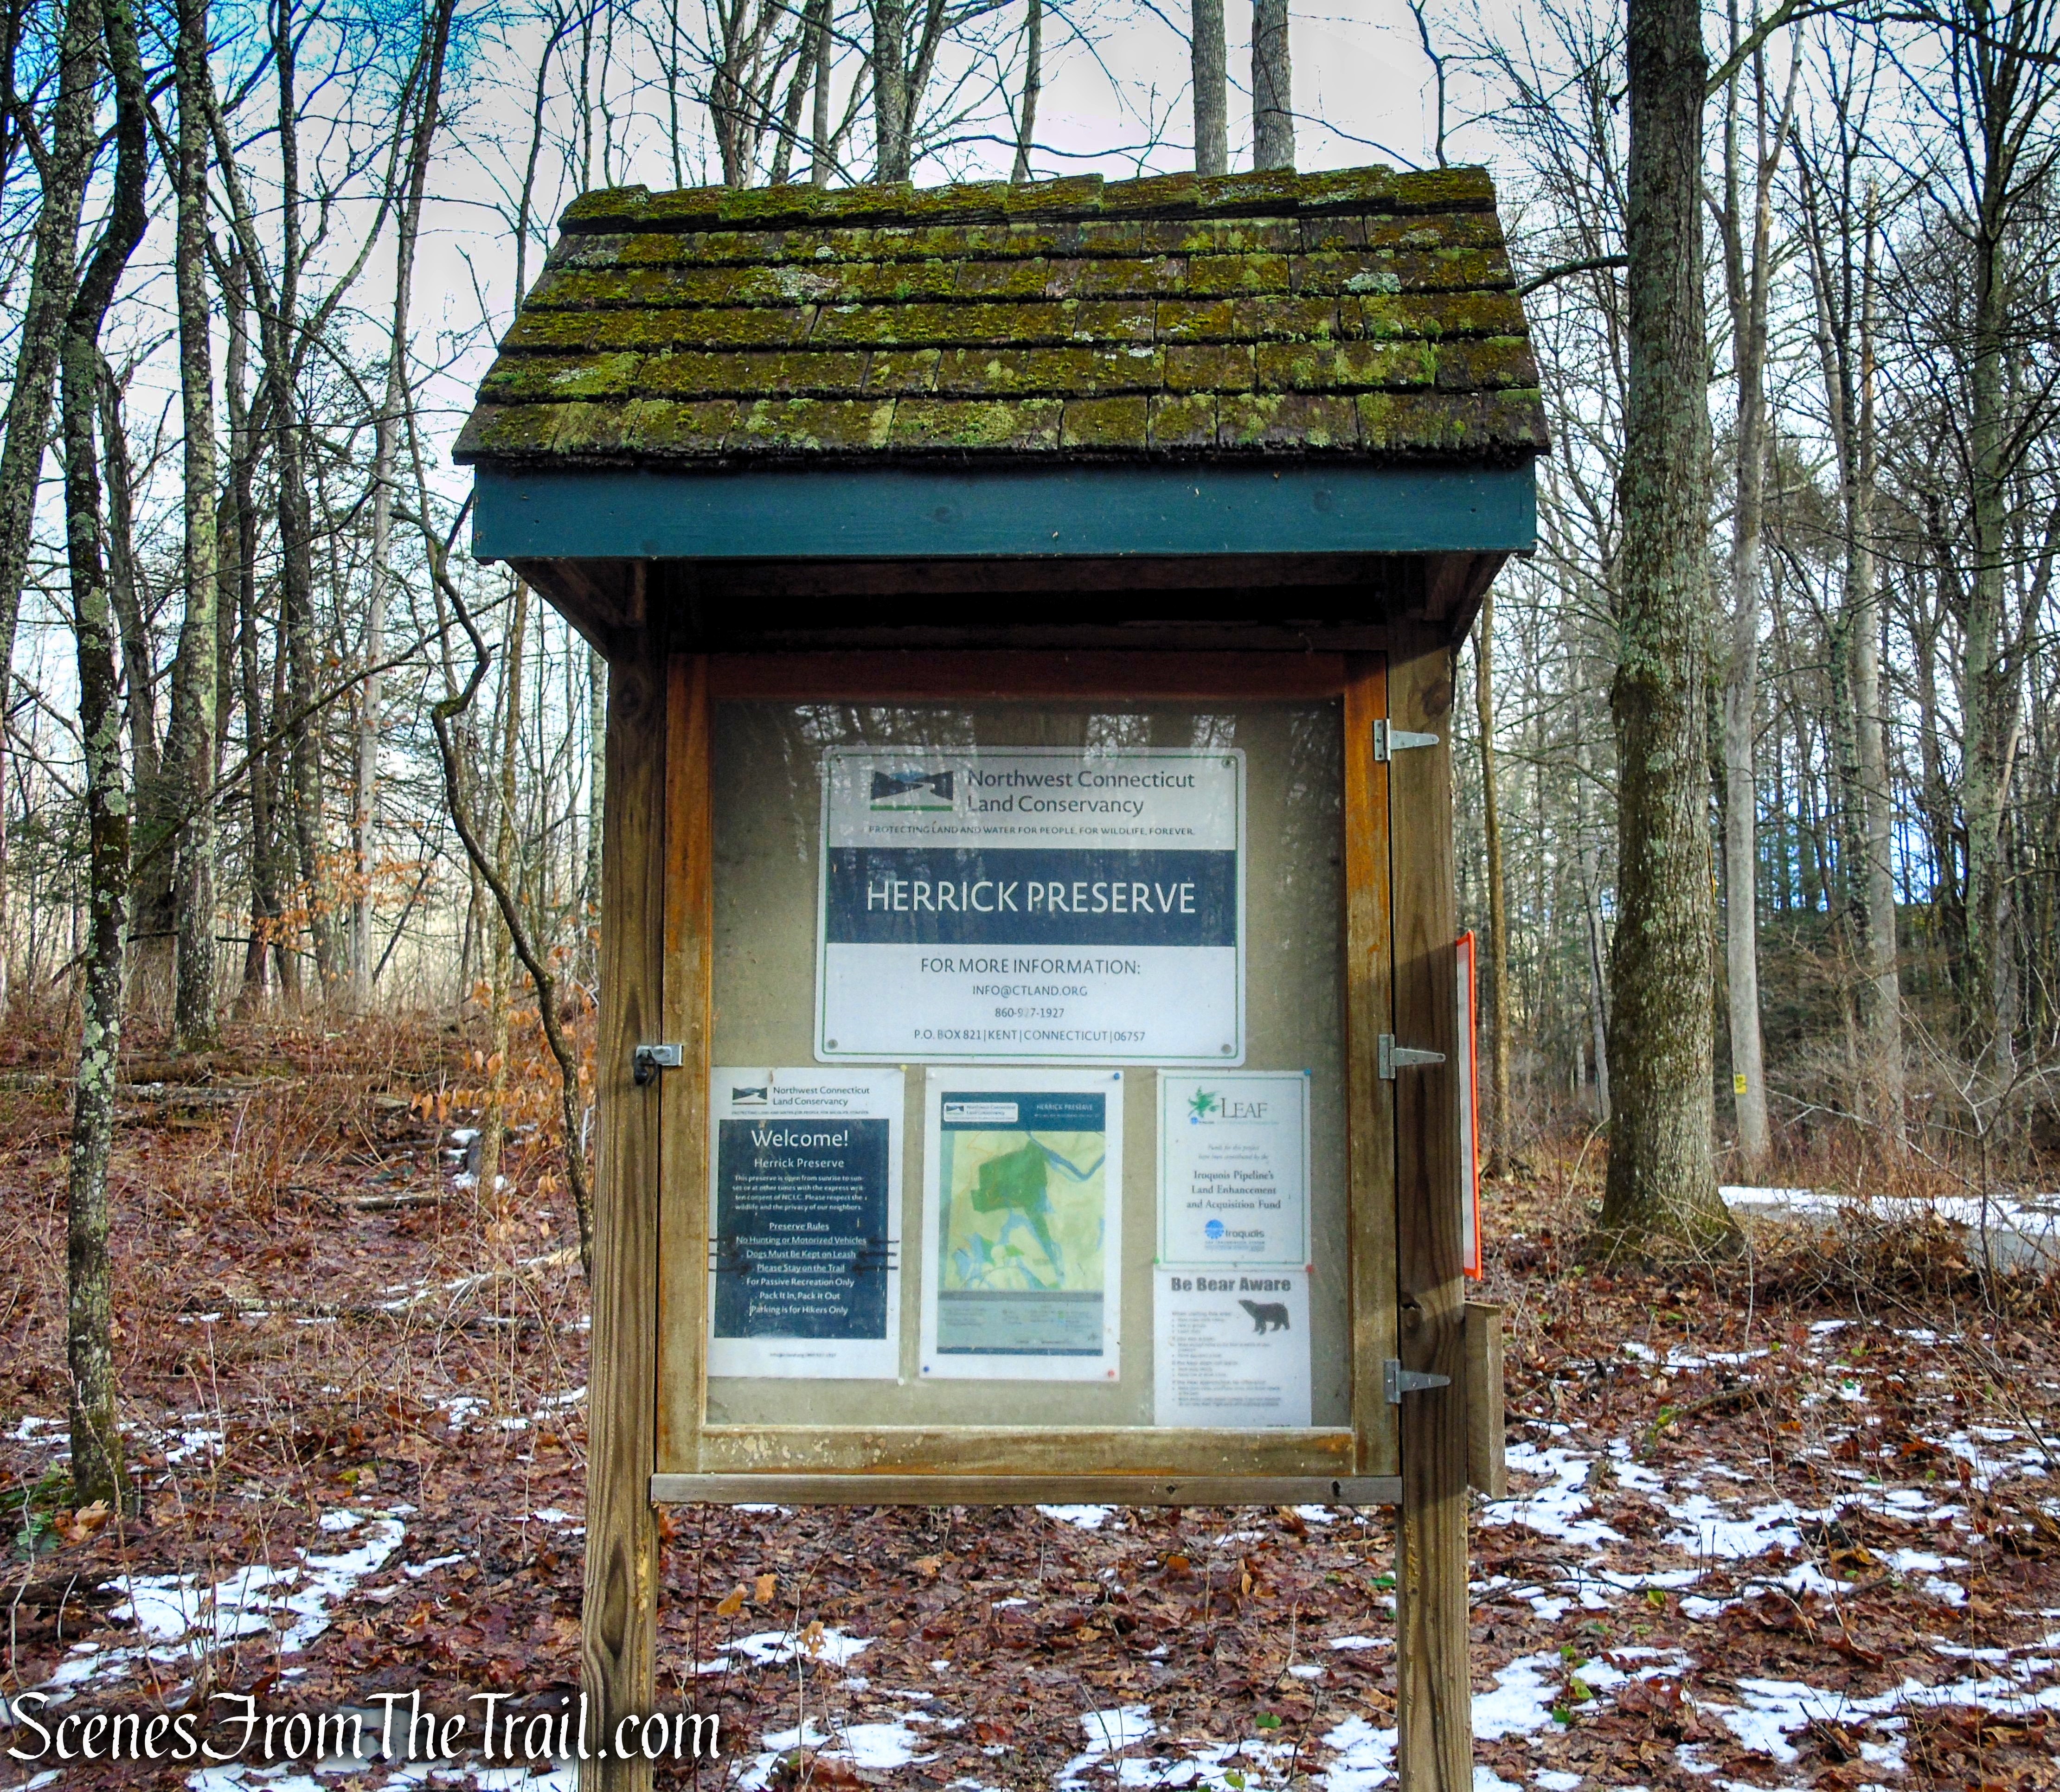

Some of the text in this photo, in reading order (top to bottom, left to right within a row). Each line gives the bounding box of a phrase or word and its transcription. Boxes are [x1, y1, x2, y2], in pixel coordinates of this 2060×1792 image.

[968, 769, 1195, 787] Northwest Connecticut
[968, 794, 1144, 817] Land Conservancy
[869, 825, 929, 834] PROTECTING
[932, 826, 958, 834] LAND
[867, 881, 1196, 914] HERRICK PRESERVE
[921, 958, 1141, 974] FOR MORE INFORMATION:
[972, 985, 1088, 998] INFO@CTLAND.ORG
[914, 1029, 935, 1040] P.O.
[795, 1097, 848, 1107] Conservancy
[751, 1128, 848, 1147] Welcome!
[754, 1158, 845, 1168] Herrick Preserve
[1194, 1170, 1274, 1182] Iroquois Pipeline's
[1191, 1184, 1277, 1195] Land Enhancement
[1186, 1199, 1282, 1211] and Acquisition Fund
[769, 1222, 829, 1230] Preserve Rules
[1225, 1229, 1265, 1239] Iroquois
[750, 1236, 780, 1246] Hunting
[791, 1236, 833, 1244] Motorized
[834, 1236, 866, 1244] Vehicles
[746, 1250, 767, 1259] Dogs
[768, 1250, 789, 1258] Must
[790, 1250, 800, 1258] Be
[802, 1250, 820, 1259] Kept
[833, 1250, 856, 1259] Leash
[757, 1264, 782, 1272] Please
[783, 1264, 801, 1273] Stay
[813, 1264, 826, 1272] the
[828, 1264, 845, 1272] Trail
[791, 1278, 834, 1286] Recreation
[835, 1278, 855, 1287] Only
[1171, 1277, 1291, 1292] Be Bear Aware
[797, 1291, 816, 1299] Pack
[824, 1292, 841, 1300] Out
[750, 1305, 781, 1315] Parking
[789, 1305, 801, 1313] for
[802, 1305, 827, 1314] Hikers
[828, 1306, 848, 1316] Only
